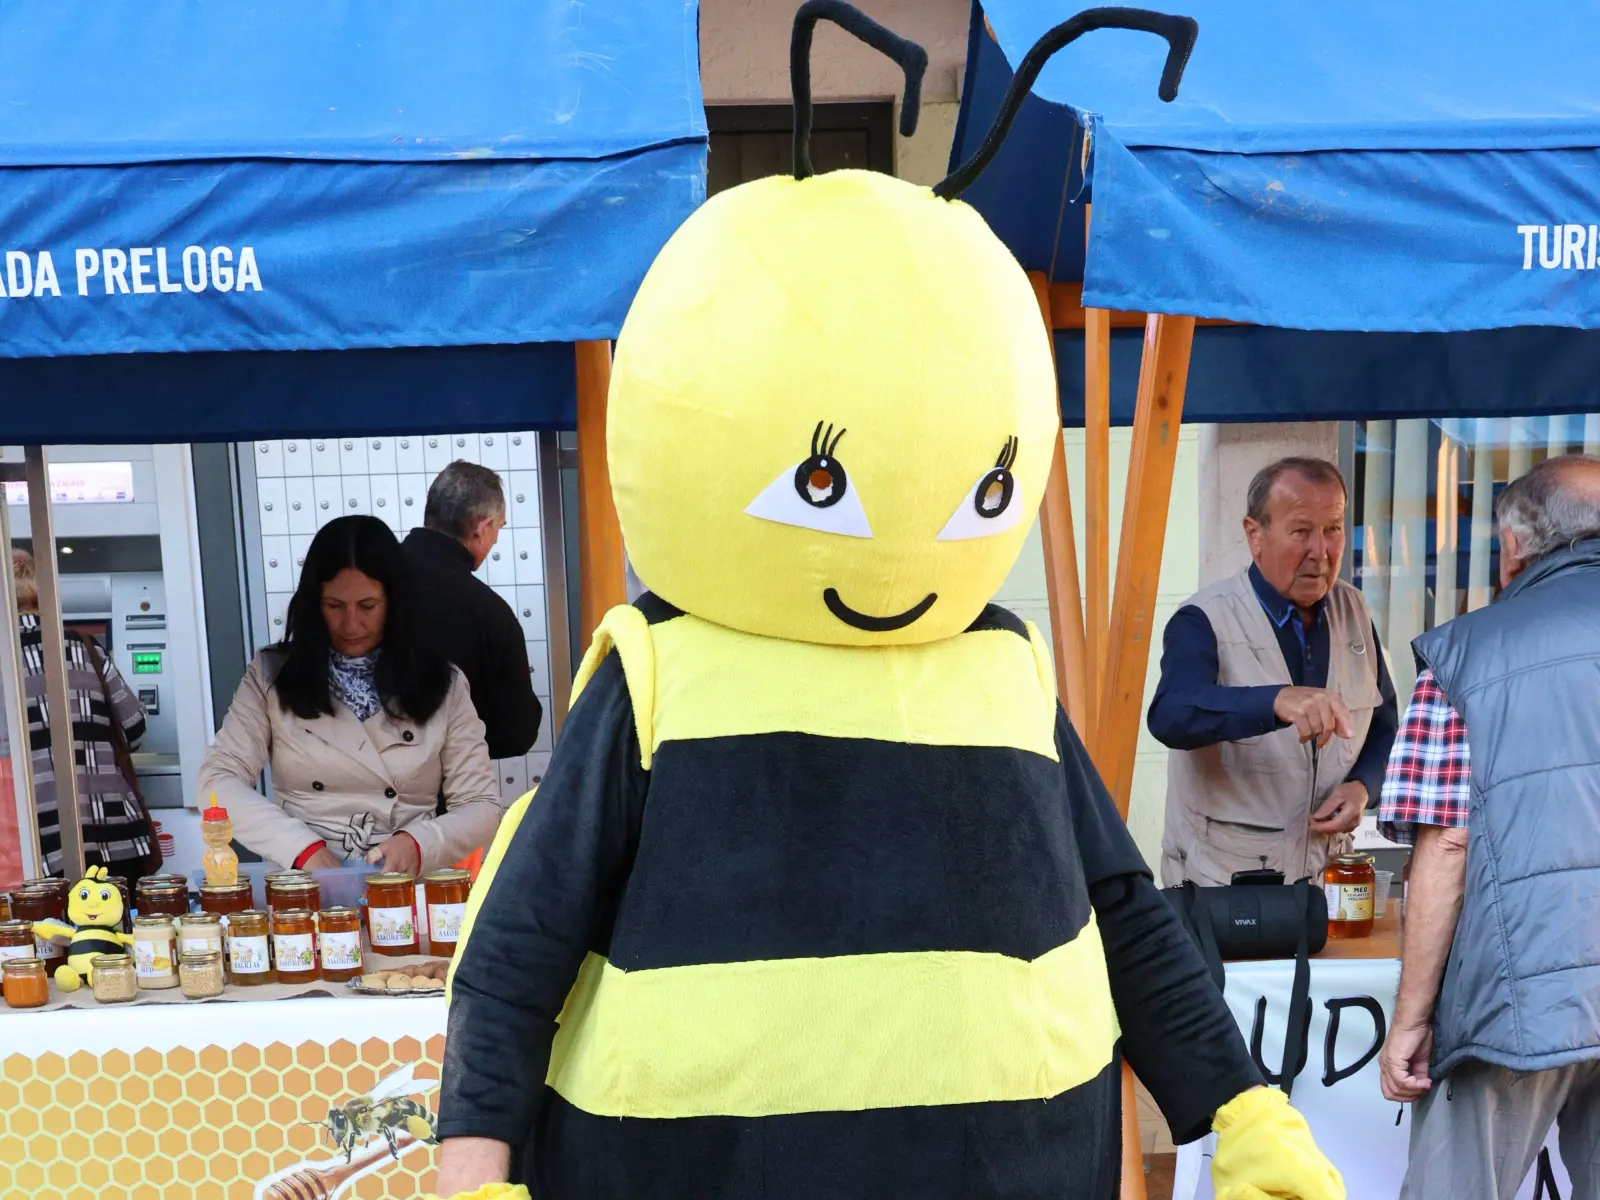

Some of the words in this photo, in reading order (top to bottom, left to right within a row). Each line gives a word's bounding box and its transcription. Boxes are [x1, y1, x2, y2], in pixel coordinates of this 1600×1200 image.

[1517, 224, 1600, 270] TURI
[0, 251, 62, 297] DA
[75, 245, 263, 297] PRELOGA
[1234, 918, 1257, 926] VIVAX
